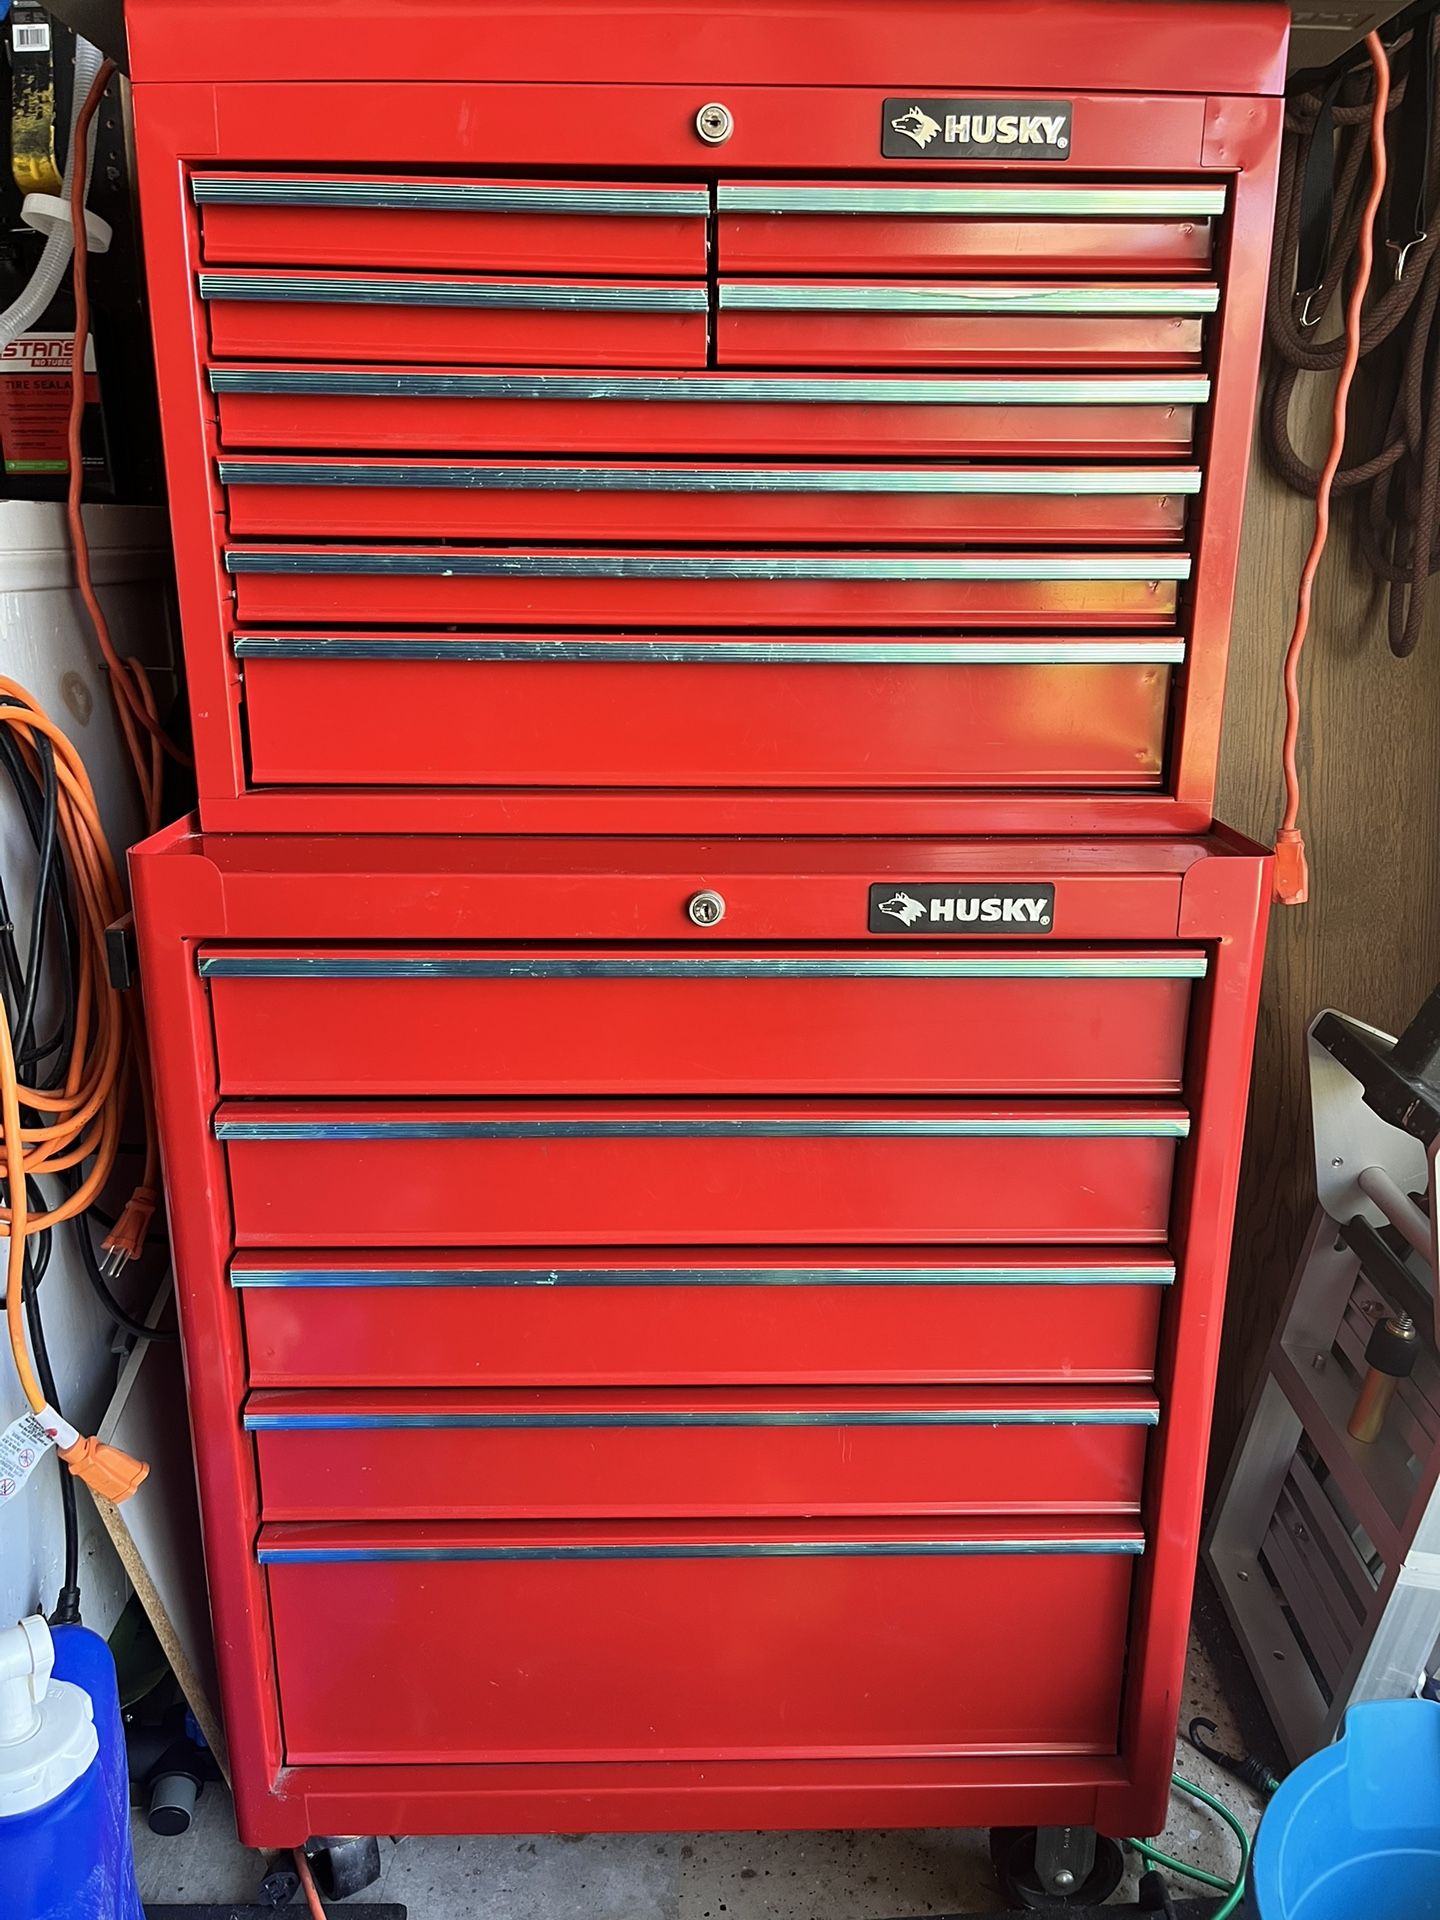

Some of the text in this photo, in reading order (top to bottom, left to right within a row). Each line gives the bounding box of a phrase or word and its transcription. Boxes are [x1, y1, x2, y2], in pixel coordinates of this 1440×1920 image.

[944, 115, 1066, 144] HUSKY
[34, 359, 73, 367] NO TUBES
[6, 380, 72, 390] TIRE SEALA
[930, 898, 1048, 922] HUSKY
